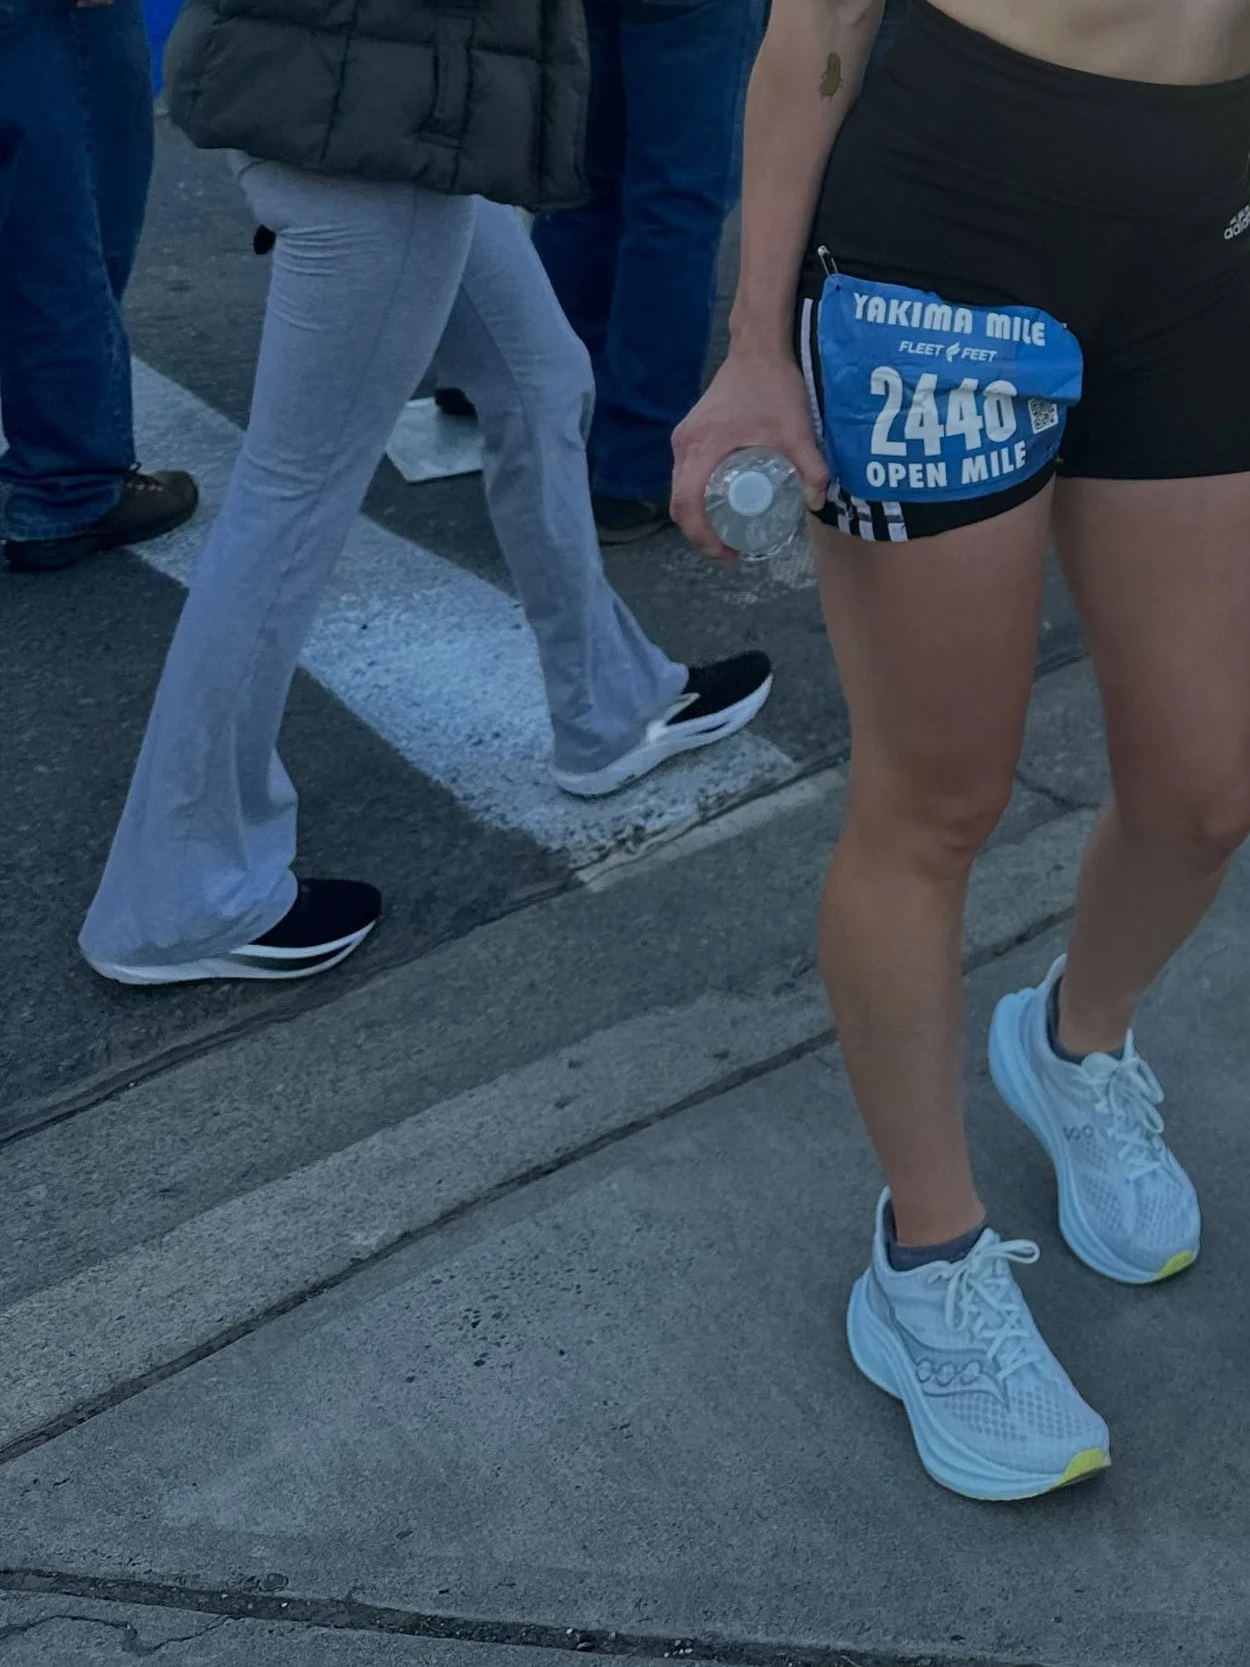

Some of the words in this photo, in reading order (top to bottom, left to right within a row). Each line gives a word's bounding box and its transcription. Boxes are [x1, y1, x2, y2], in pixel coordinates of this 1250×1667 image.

[853, 292, 973, 334] YAKIMA
[986, 312, 1046, 347] MILE
[898, 340, 945, 357] FLEET
[960, 347, 998, 362] FEET
[870, 366, 1018, 457] 2440
[866, 461, 948, 489] OPEN
[961, 440, 1027, 486] MILE
